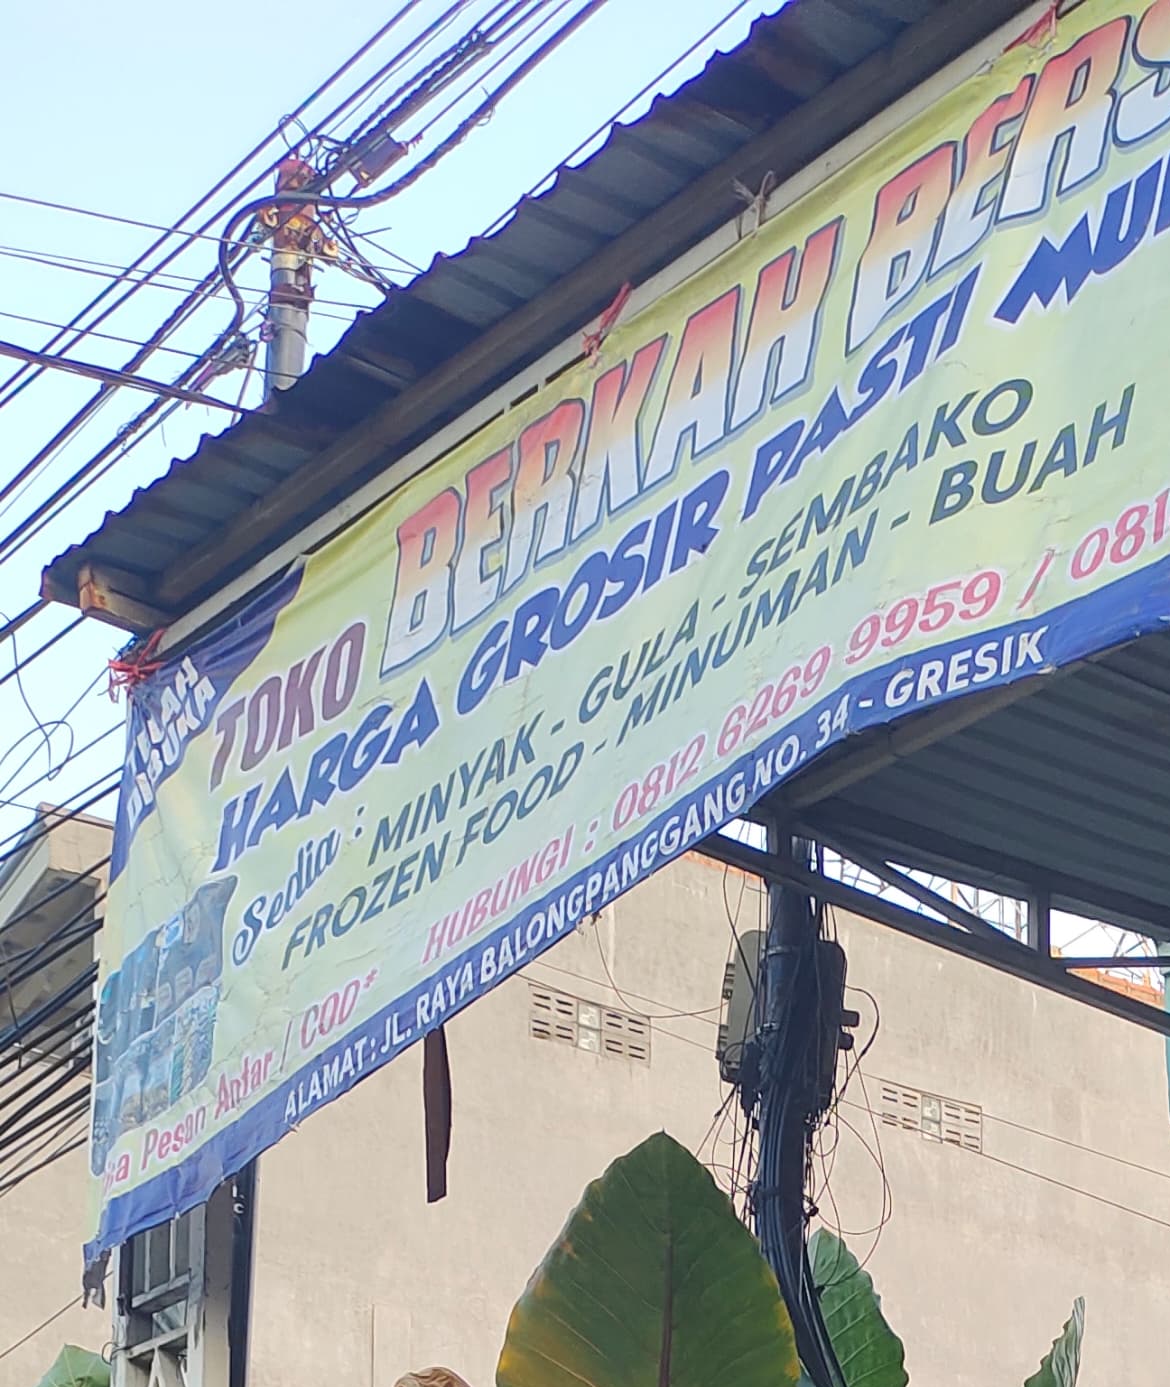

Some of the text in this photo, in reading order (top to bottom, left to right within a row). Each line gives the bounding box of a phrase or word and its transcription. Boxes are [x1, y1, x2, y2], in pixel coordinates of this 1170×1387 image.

[209, 621, 367, 793] TOKO
[380, 213, 848, 680] BERKAH
[210, 678, 440, 873] HARGA
[456, 468, 730, 714] GROSIR
[740, 259, 980, 520] PASTI
[280, 845, 448, 971] FROZEN
[455, 741, 586, 869] FOOD
[616, 511, 876, 747] MINUMAN
[927, 382, 1137, 527] BUAH
[368, 710, 554, 868] MINYAK
[578, 617, 700, 725] GULA
[745, 377, 1034, 586] SEMBAKO
[126, 675, 217, 831] DIBUKA
[232, 826, 341, 967] Sedia
[381, 1010, 412, 1055] JL.
[416, 960, 475, 1032] RAYA
[479, 773, 750, 988] BALONGPANGGANG
[752, 736, 810, 796] NO.
[815, 704, 852, 743] 34
[882, 625, 1049, 710] GRESIK
[421, 840, 571, 965] HUBUNGI
[612, 733, 701, 832] 0812
[715, 644, 832, 759] 6269
[843, 569, 1002, 668] 9959
[140, 1105, 208, 1171] Pesan
[214, 1050, 273, 1120] Antar
